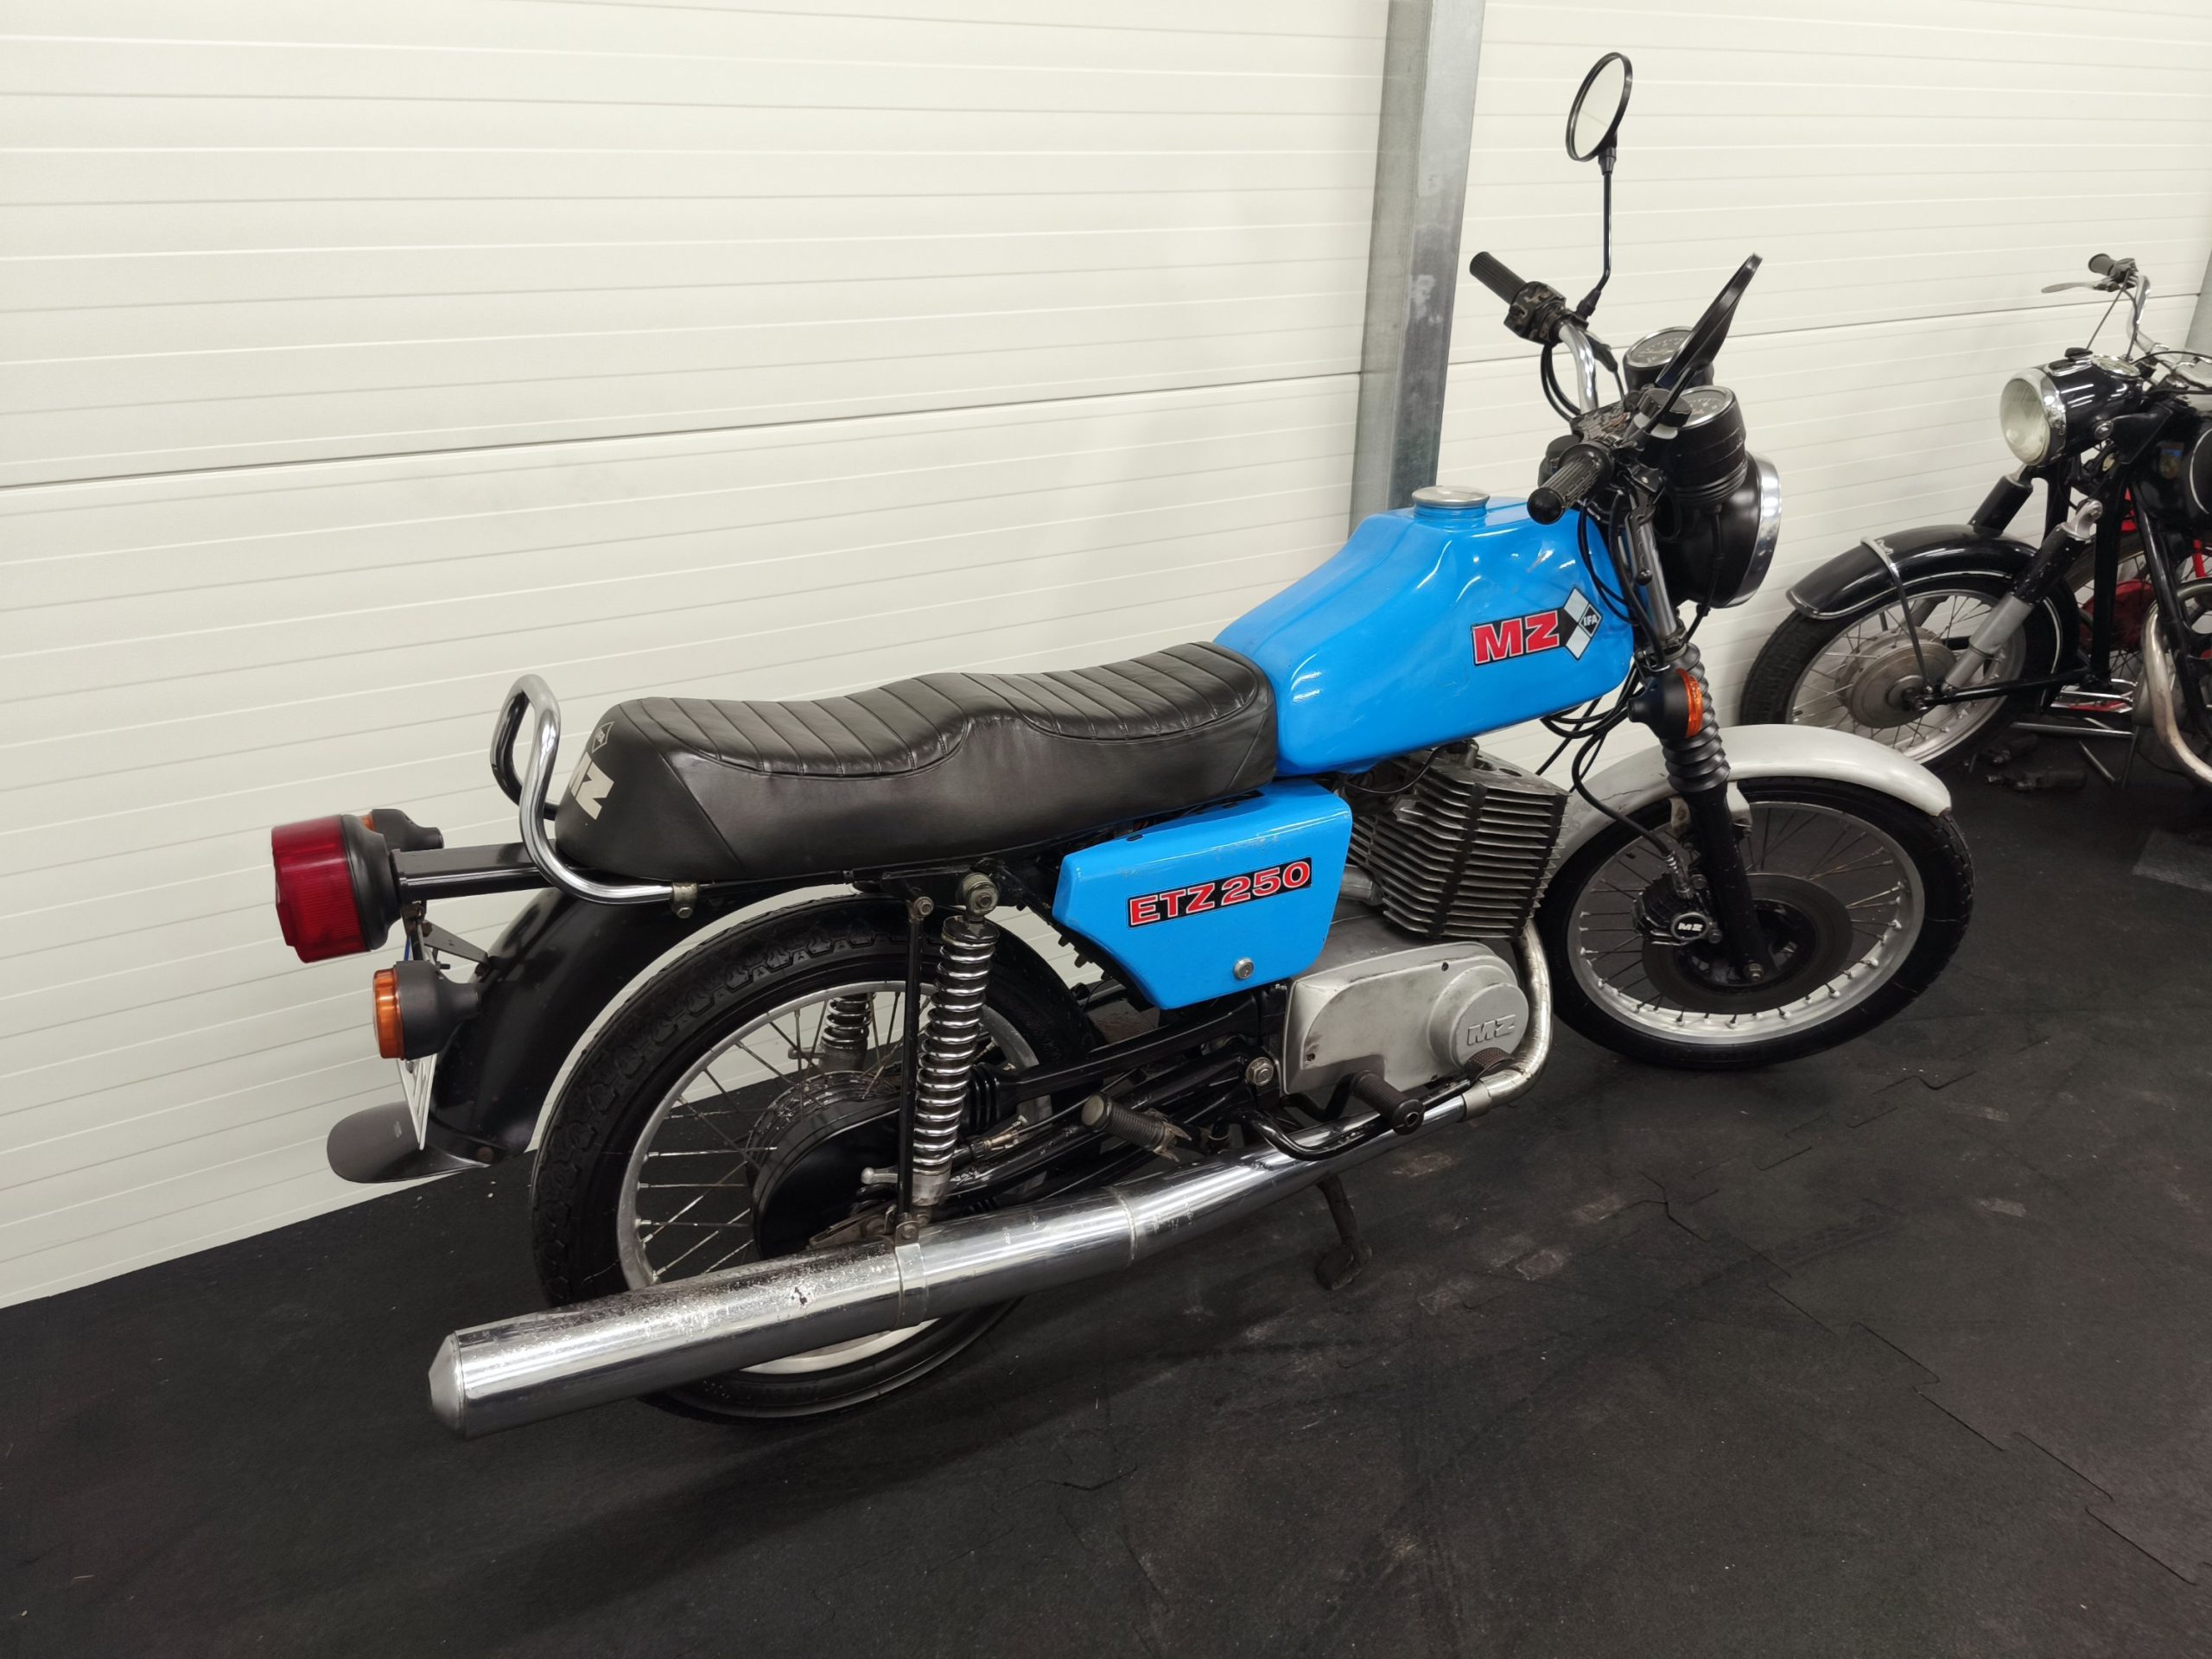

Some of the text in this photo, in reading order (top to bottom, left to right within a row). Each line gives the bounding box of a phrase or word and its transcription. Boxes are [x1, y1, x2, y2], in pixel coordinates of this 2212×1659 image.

[1582, 614, 1598, 627] IFA
[1472, 610, 1560, 664] MZ
[1130, 861, 1310, 925] ETZ 250
[1678, 922, 1703, 931] MZ
[1467, 1014, 1516, 1046] MZ
